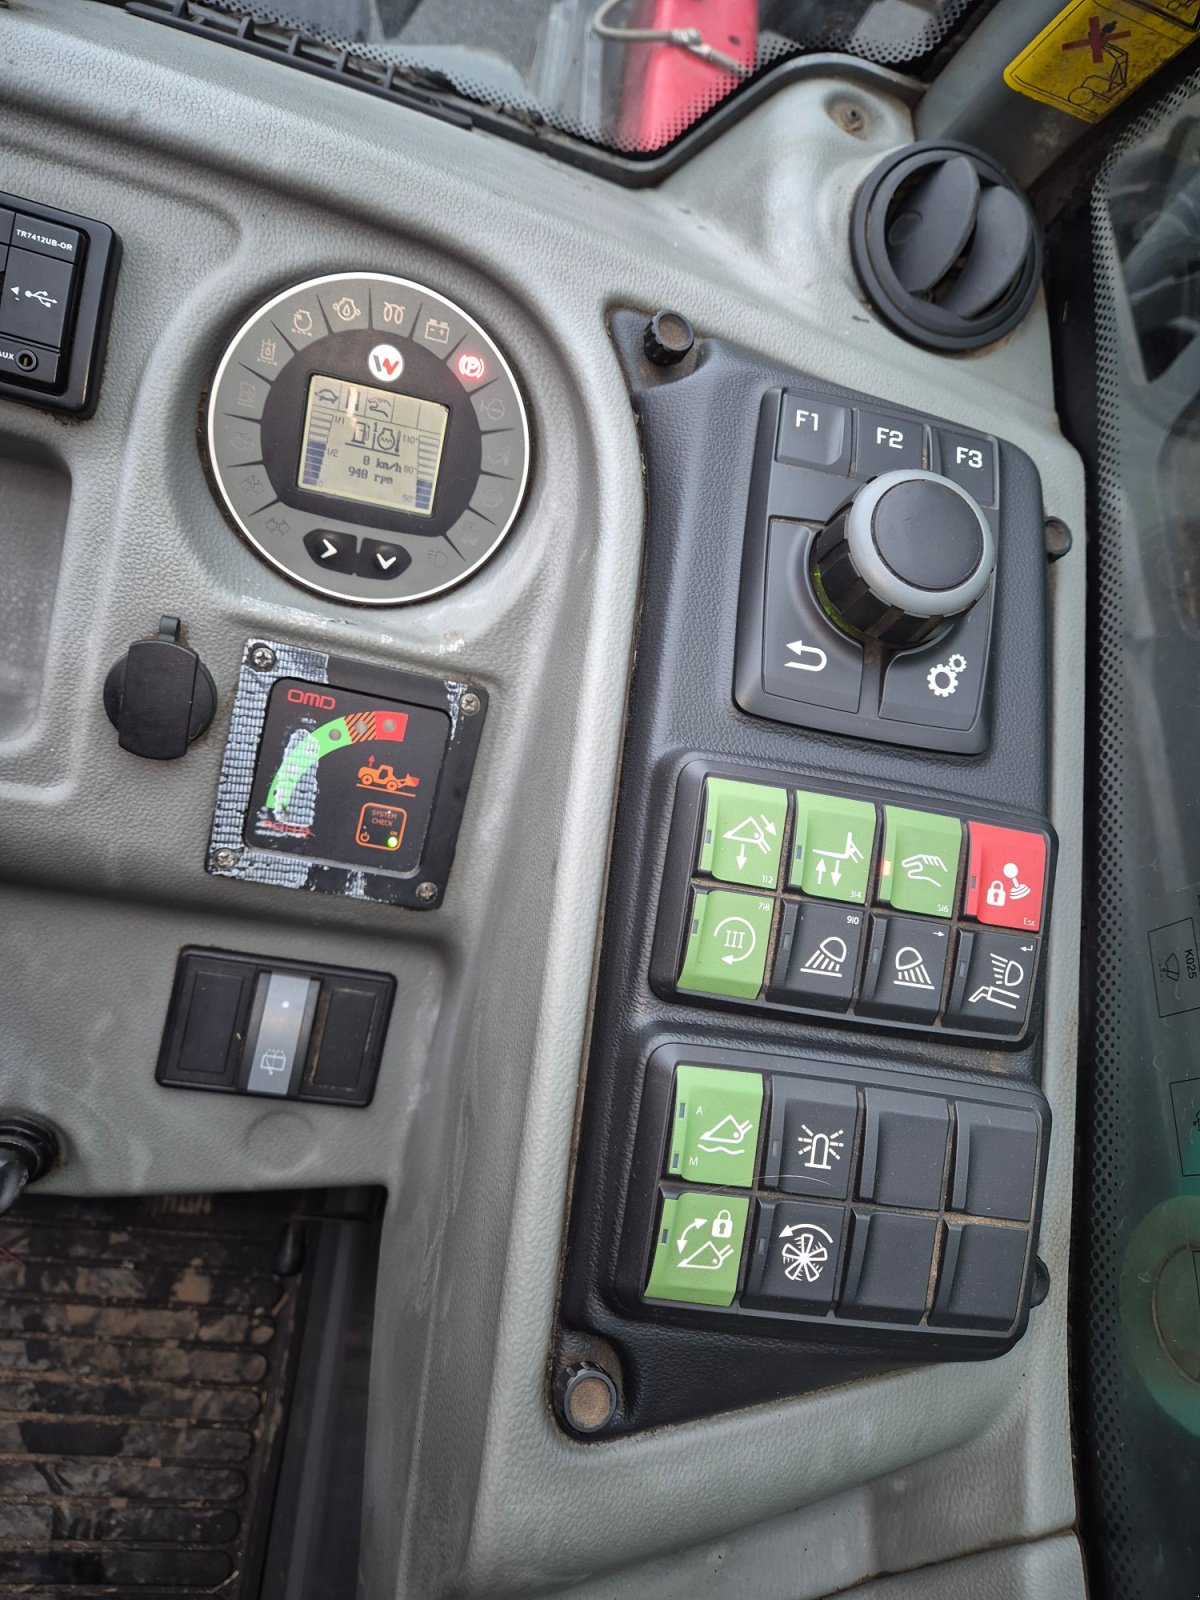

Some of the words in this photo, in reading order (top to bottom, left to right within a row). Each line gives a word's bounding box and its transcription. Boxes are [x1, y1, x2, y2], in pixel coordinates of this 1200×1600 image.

[16, 229, 73, 251] TR7412UB-OR
[795, 409, 819, 431] F1
[876, 426, 904, 449] F2
[956, 446, 983, 469] F3
[374, 474, 394, 485] rpm
[371, 817, 394, 827] CHECK
[1023, 917, 1036, 927] Esc
[1185, 949, 1197, 979] K025
[696, 1105, 703, 1116] A
[689, 1156, 698, 1166] M
